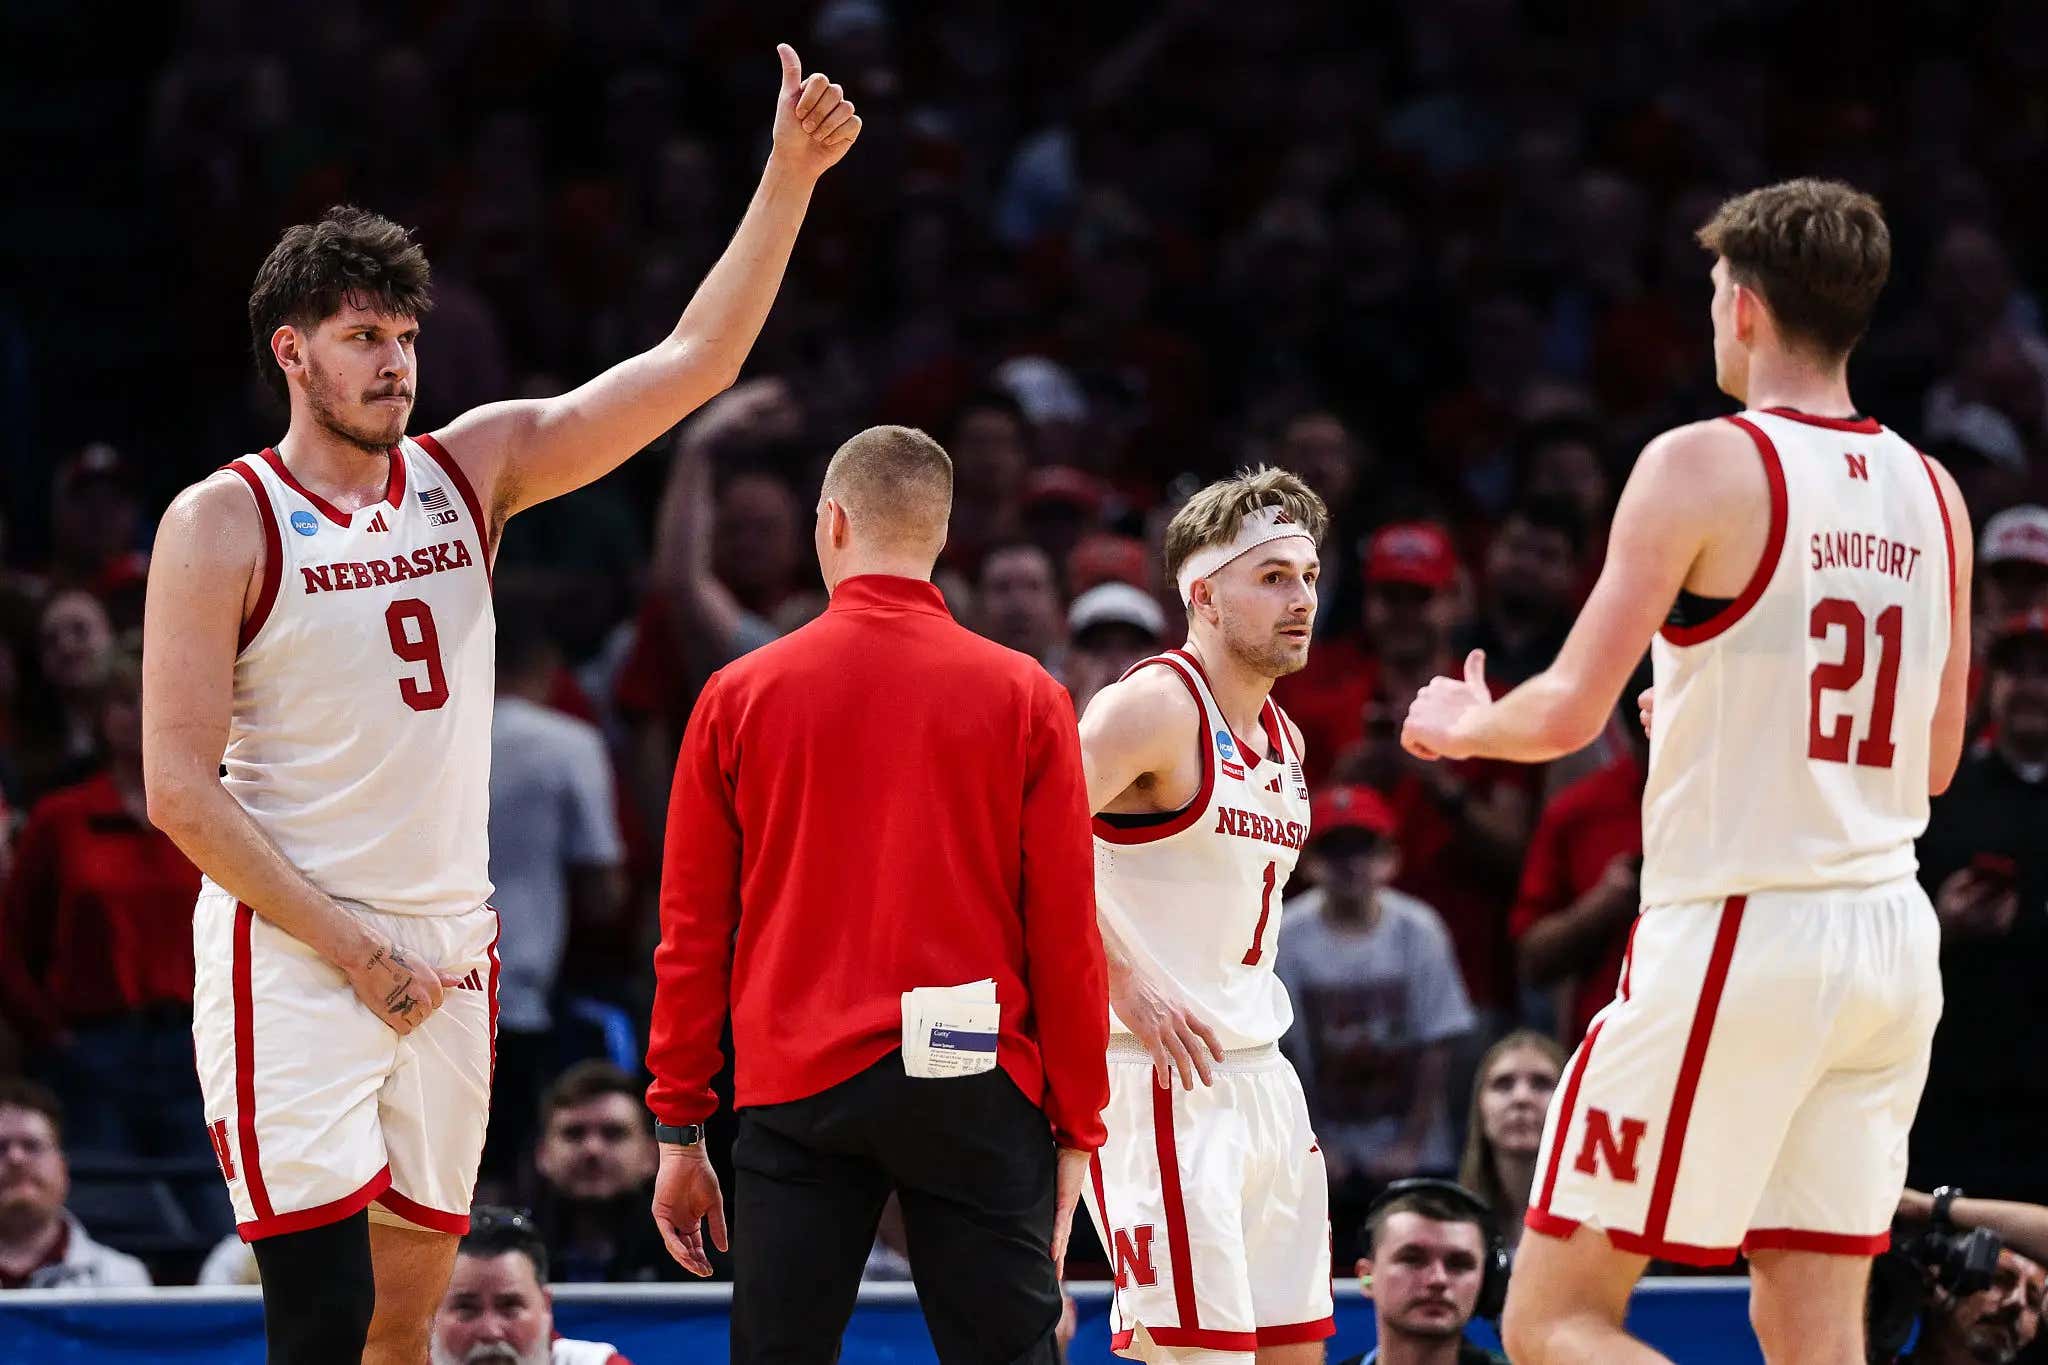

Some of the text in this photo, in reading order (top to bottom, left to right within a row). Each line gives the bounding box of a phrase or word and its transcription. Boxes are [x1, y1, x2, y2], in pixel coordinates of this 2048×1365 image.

[1845, 453, 1868, 481] N
[300, 539, 472, 594] NEBRASKA
[385, 598, 449, 711] 9
[1808, 597, 1903, 769] 21
[1241, 861, 1275, 966] 1
[1574, 1106, 1647, 1184] N
[1114, 1223, 1158, 1290] N
